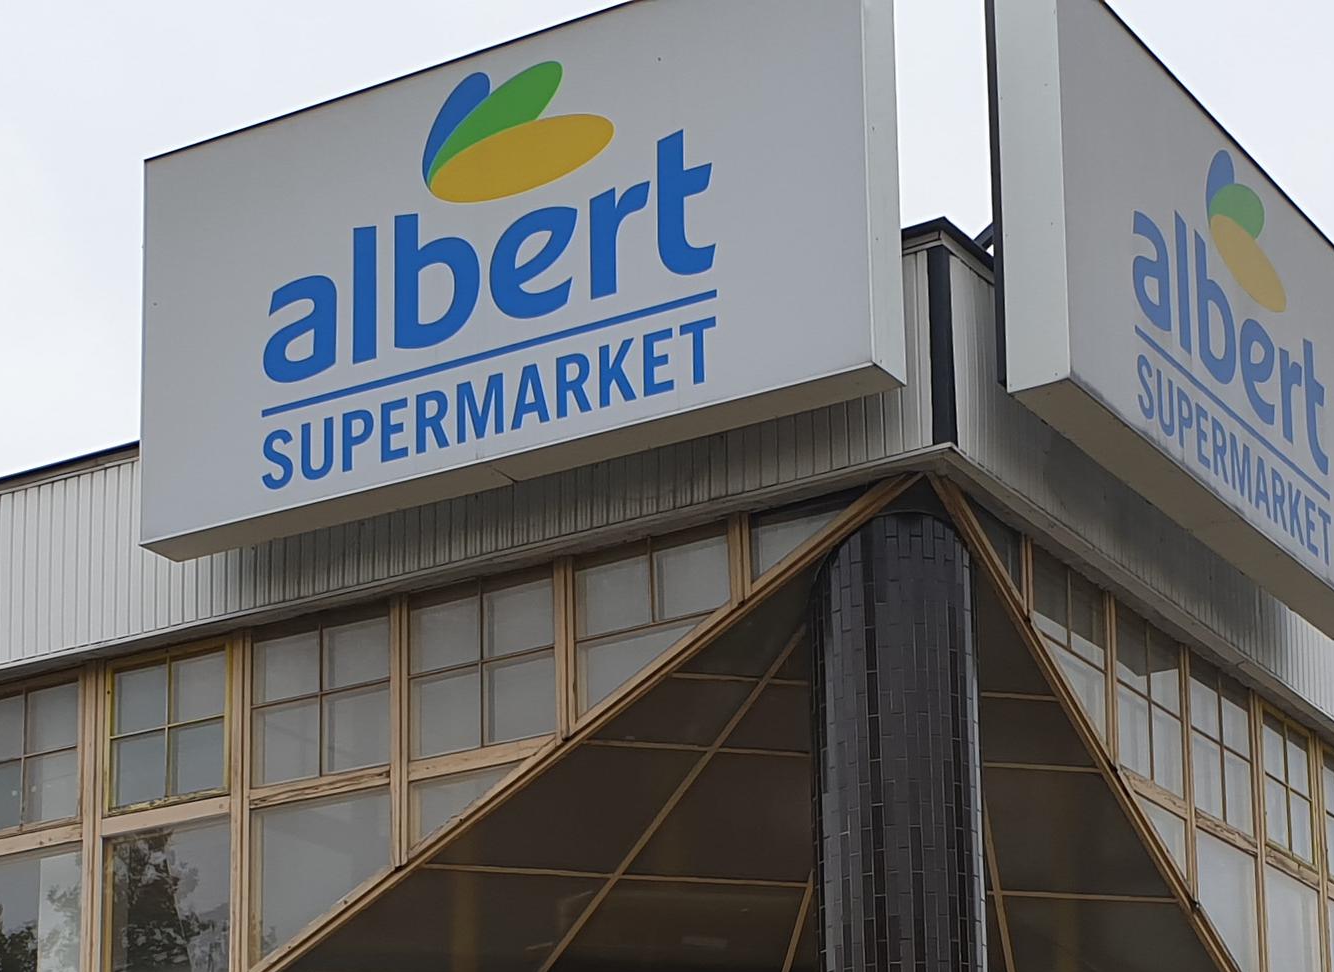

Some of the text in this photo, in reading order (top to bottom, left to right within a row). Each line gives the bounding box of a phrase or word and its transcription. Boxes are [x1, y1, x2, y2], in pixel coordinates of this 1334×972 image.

[263, 128, 716, 383] albert
[1132, 210, 1329, 476] albert
[262, 316, 717, 490] SUPERMARKET
[1136, 354, 1332, 566] SUPERMARKET
